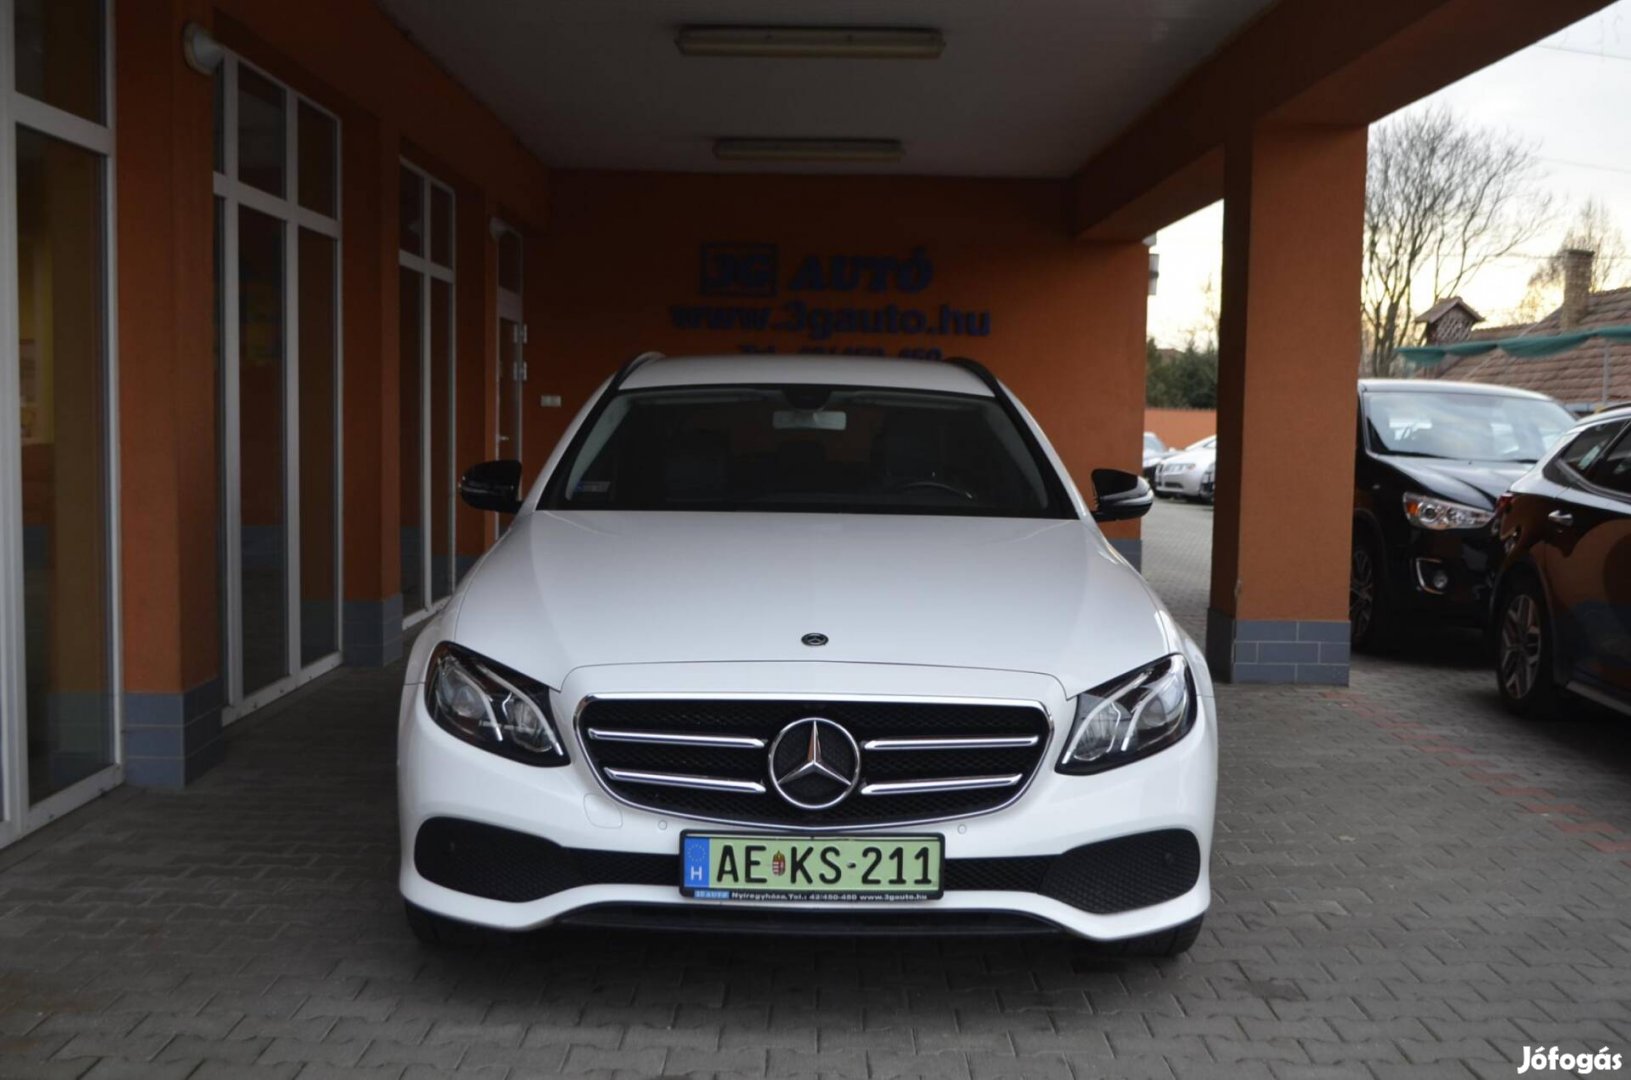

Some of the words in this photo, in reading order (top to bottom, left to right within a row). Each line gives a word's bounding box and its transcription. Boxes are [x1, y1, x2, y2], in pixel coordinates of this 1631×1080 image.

[789, 246, 935, 294] AUTÓ
[669, 300, 991, 340] www.3gauto.hu
[690, 866, 703, 881] H
[716, 845, 768, 884] AE
[790, 846, 933, 886] KS-211
